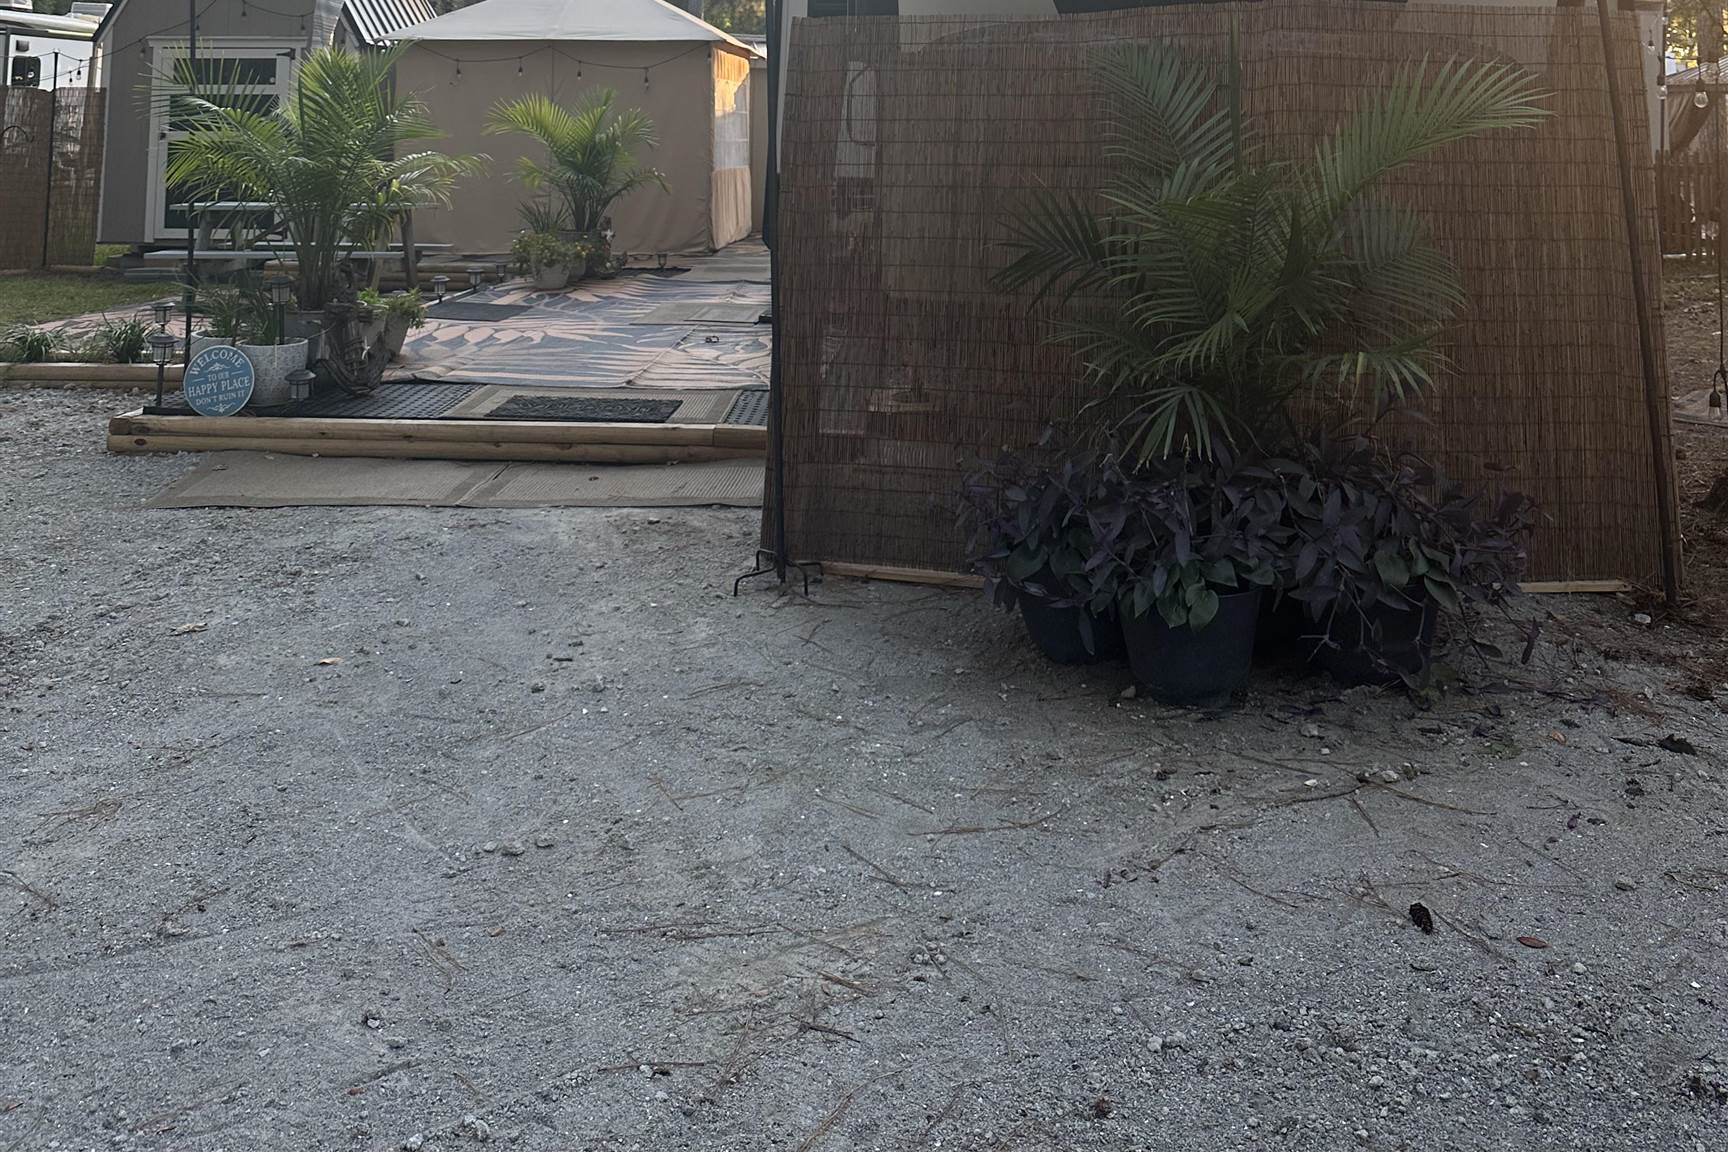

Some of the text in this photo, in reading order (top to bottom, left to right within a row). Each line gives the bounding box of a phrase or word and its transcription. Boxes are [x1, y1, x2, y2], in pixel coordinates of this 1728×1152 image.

[189, 349, 245, 375] WELCOME
[188, 375, 250, 397] HAPPY PLACE
[208, 373, 217, 381] TO
[196, 390, 245, 405] DON'T RUIN IT
